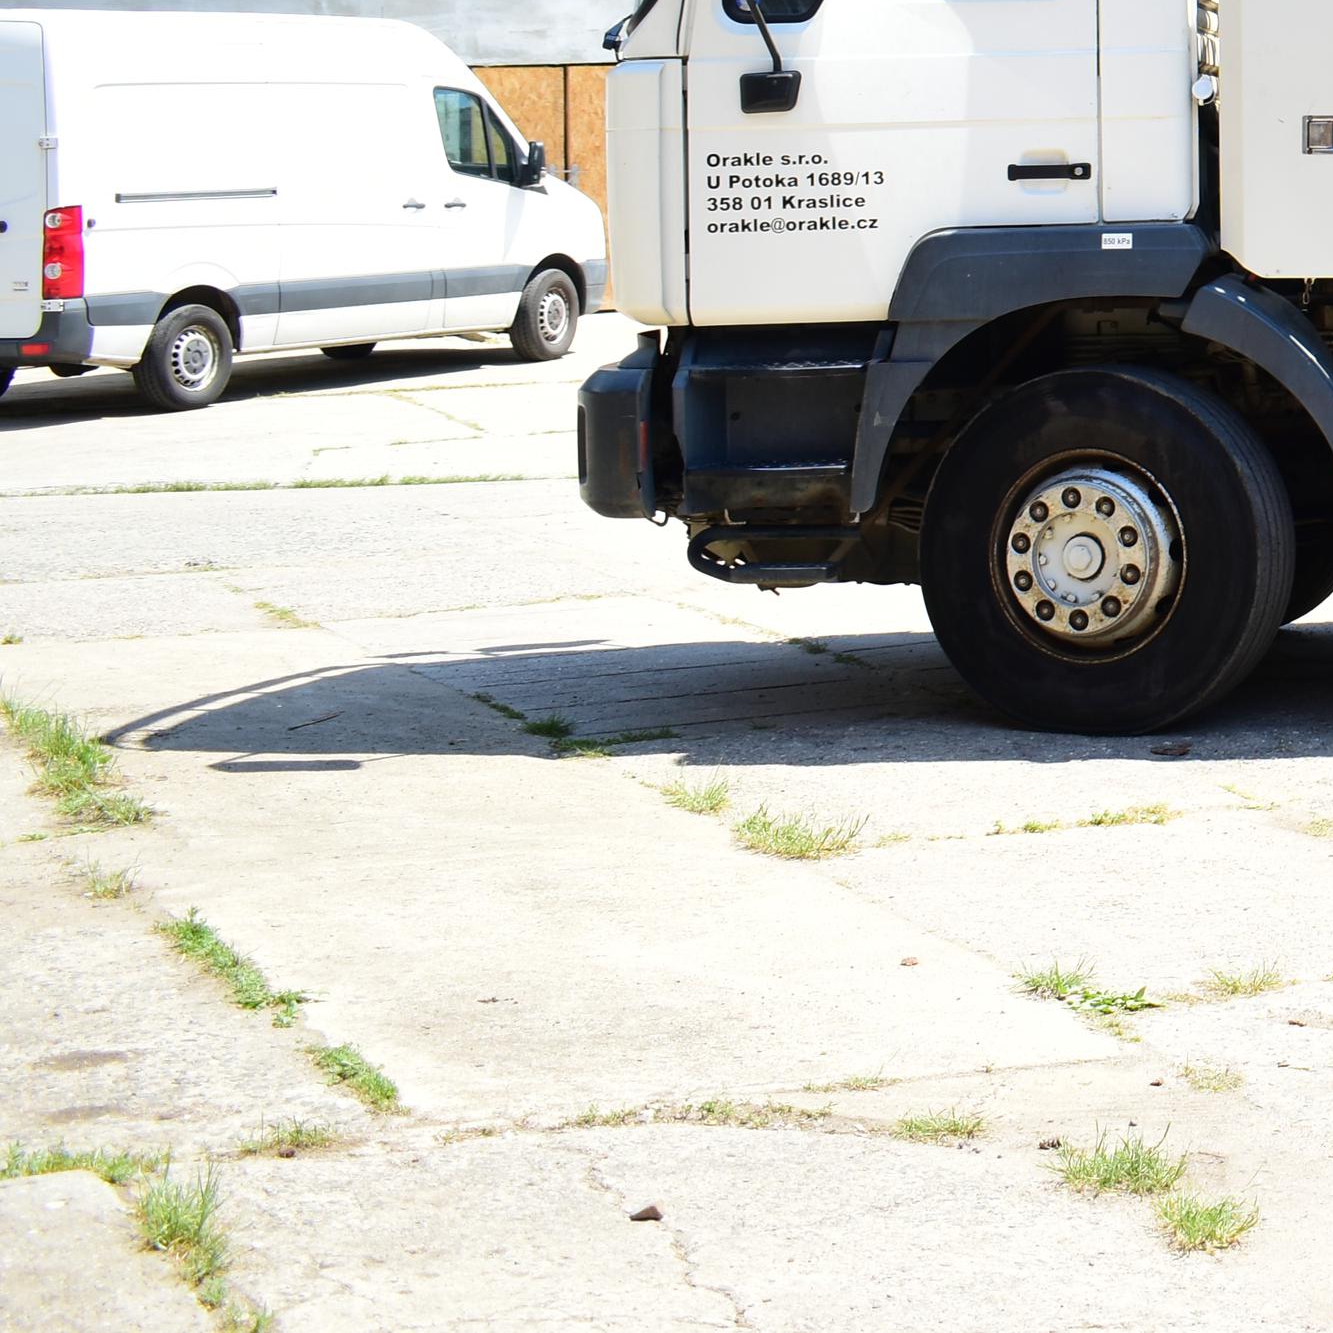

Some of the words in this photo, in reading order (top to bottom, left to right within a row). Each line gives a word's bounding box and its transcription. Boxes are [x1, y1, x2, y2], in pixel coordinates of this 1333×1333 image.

[706, 152, 774, 168] Orakle
[780, 154, 828, 166] s.r.o.
[706, 175, 721, 190] U
[728, 174, 798, 189] Potoka
[806, 171, 884, 187] 1689/13
[707, 197, 743, 212] 358
[750, 195, 772, 211] 01
[782, 194, 866, 210] Kraslice
[707, 216, 878, 234] orakle@orakle.cz
